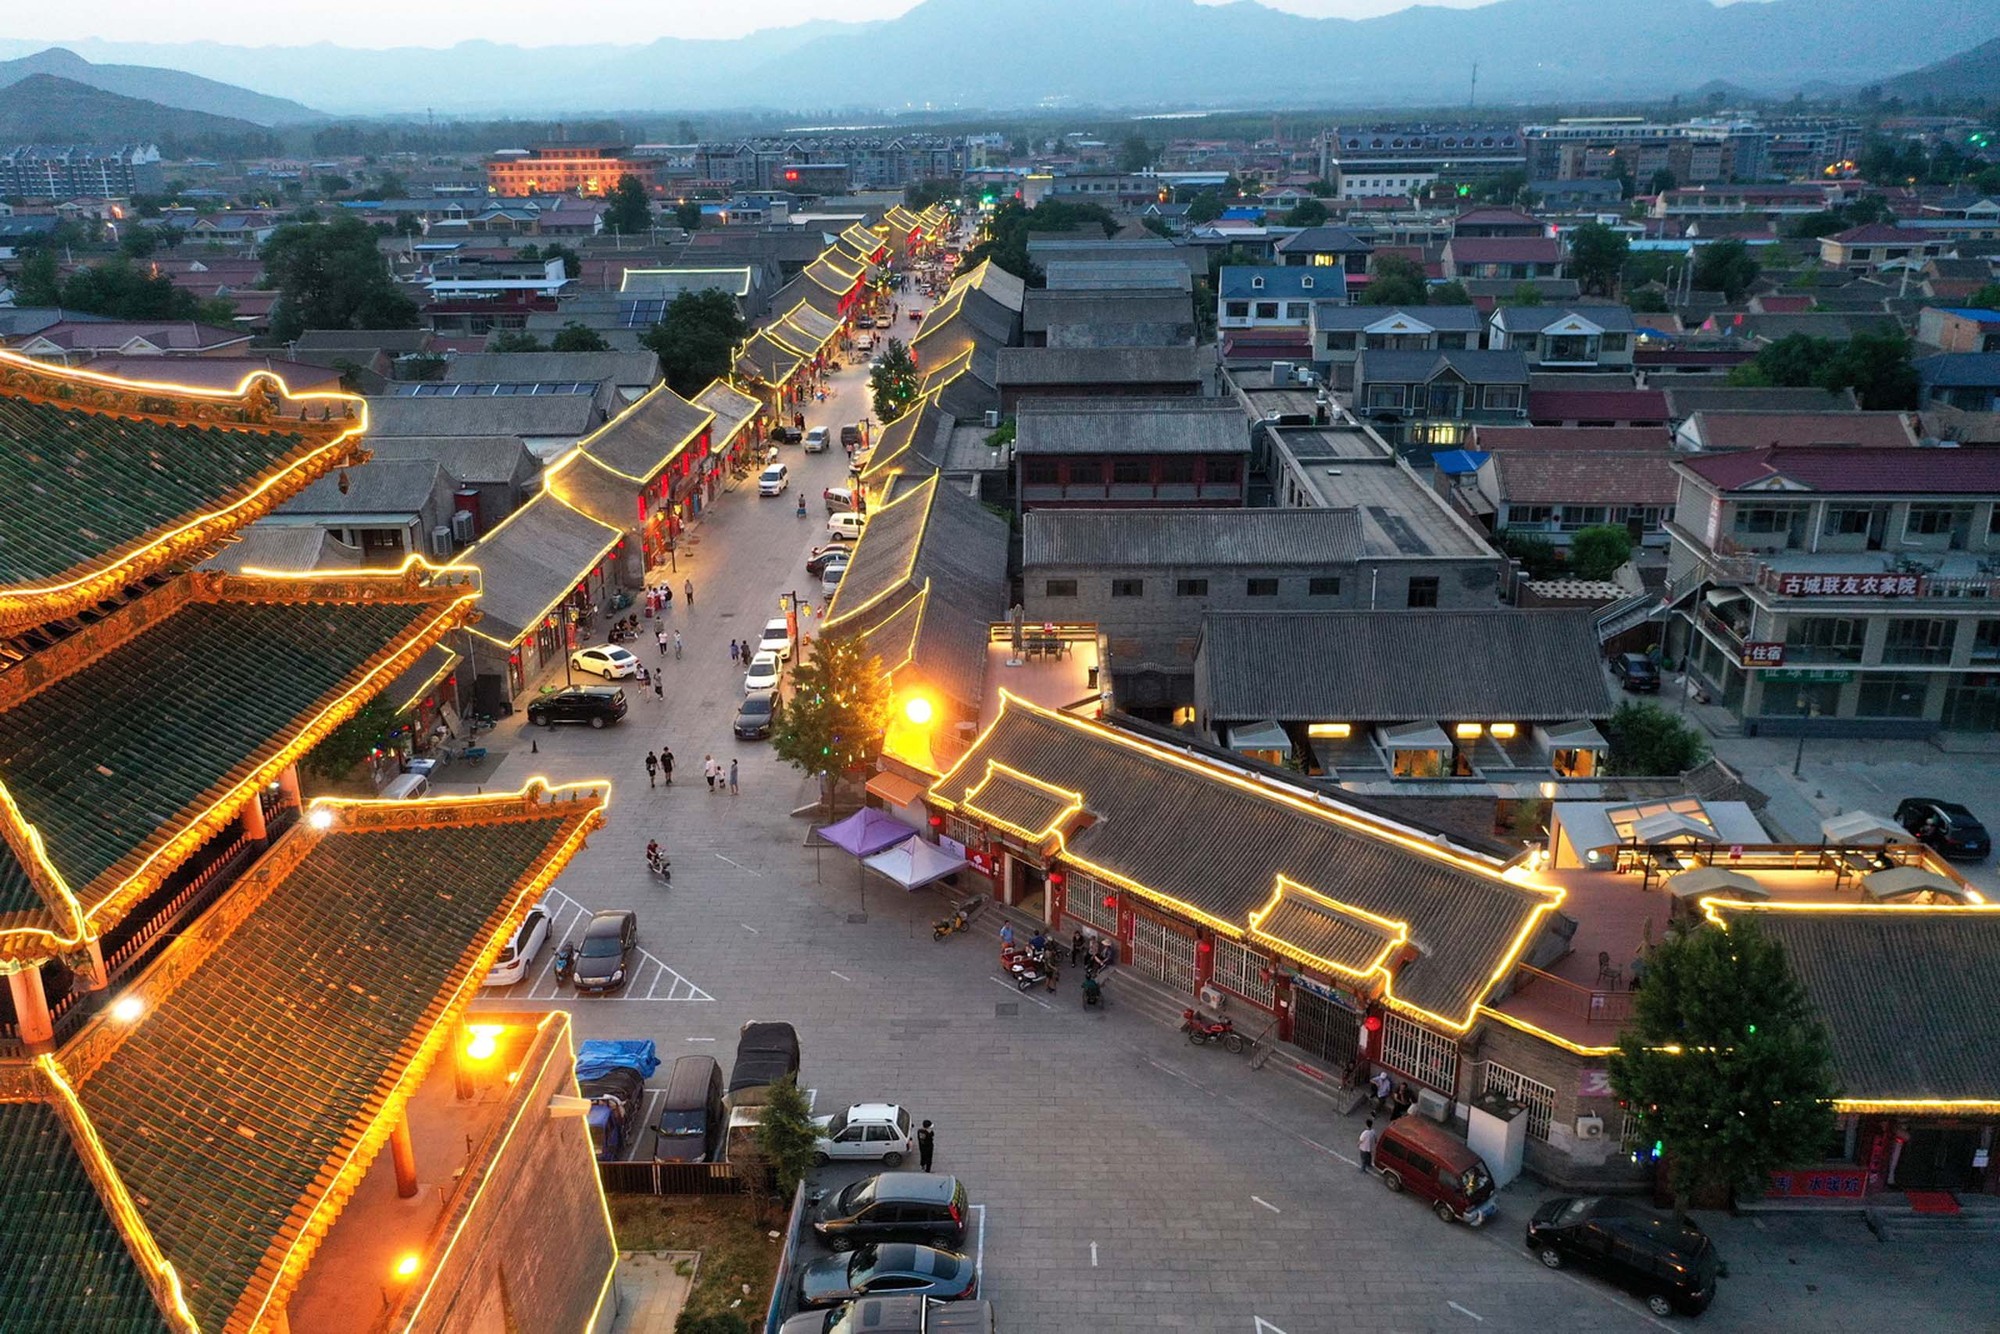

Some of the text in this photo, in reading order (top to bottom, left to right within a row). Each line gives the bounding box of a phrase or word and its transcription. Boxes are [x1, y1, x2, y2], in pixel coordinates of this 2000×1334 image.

[1785, 576, 1917, 594] 古城联友农家院
[1752, 645, 1782, 660] 住宿
